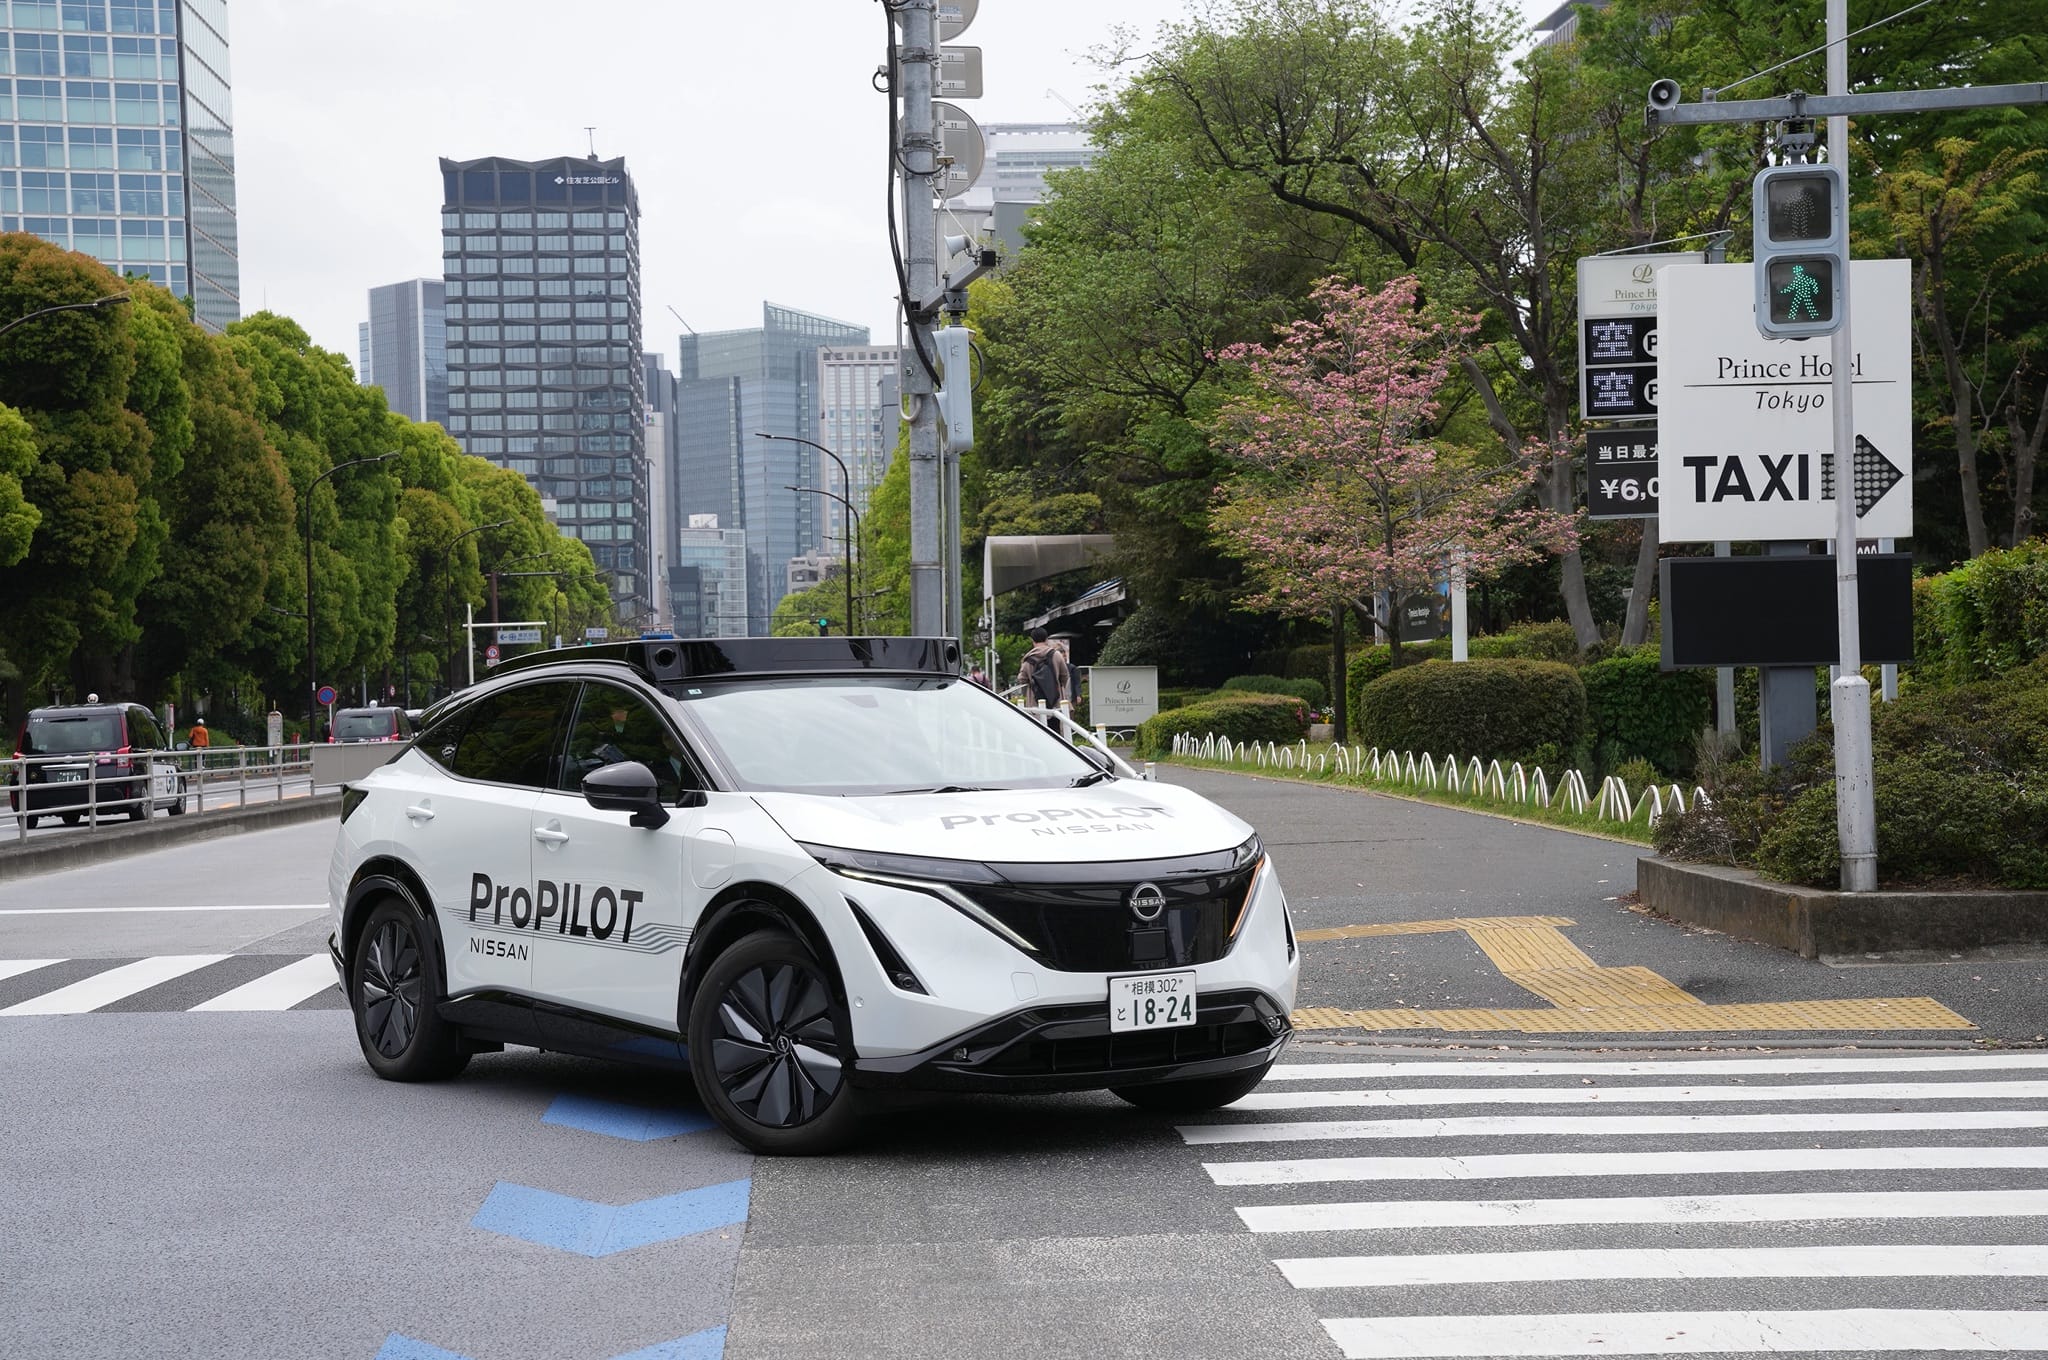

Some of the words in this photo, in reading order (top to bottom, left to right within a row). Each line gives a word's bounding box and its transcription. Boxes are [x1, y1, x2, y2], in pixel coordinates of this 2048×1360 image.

[1615, 289, 1644, 299] Prince
[1592, 322, 1633, 357] 空
[1718, 357, 1791, 379] Prince
[1593, 372, 1634, 407] 空
[1756, 391, 1825, 413] Tokyo
[1683, 454, 1809, 502] TAXI
[939, 806, 1175, 830] ProPILOT
[1031, 822, 1156, 837] NISSAN
[469, 872, 644, 943] ProPILOT
[1129, 897, 1167, 908] NISSAN
[470, 937, 529, 961] NISSAN
[1117, 1007, 1127, 1021] と
[1134, 994, 1192, 1026] 18-24
